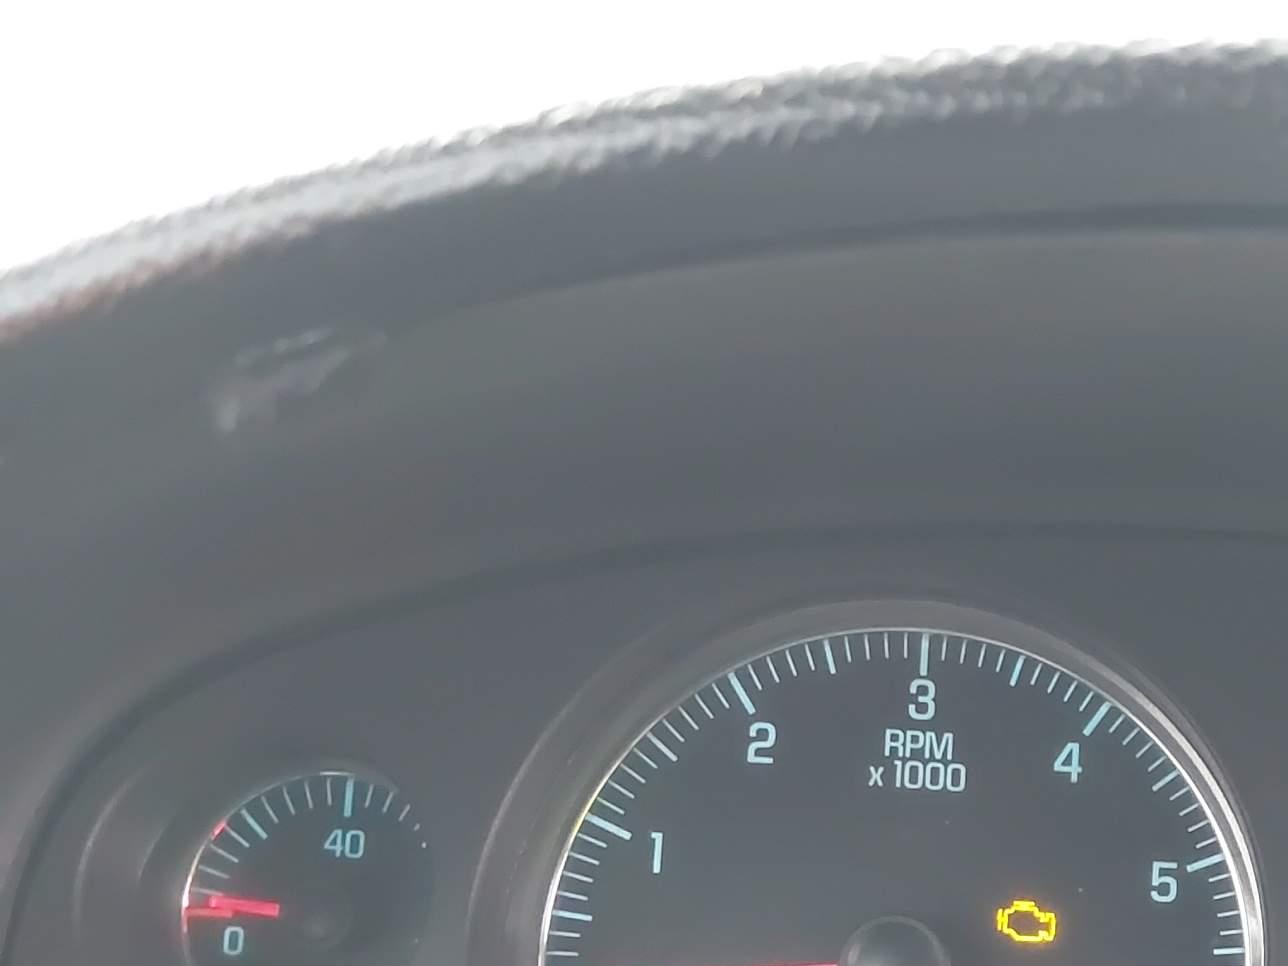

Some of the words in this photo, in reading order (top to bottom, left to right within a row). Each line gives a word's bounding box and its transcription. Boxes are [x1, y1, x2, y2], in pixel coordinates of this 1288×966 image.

[909, 680, 935, 720] 3
[747, 722, 776, 763] 2
[885, 730, 953, 761] RPM
[868, 767, 884, 787] x
[895, 762, 966, 792] 1000
[1054, 743, 1083, 783] 4
[324, 830, 365, 860] 40
[651, 832, 663, 874] 1
[1151, 861, 1178, 903] 5
[223, 927, 244, 956] 0
